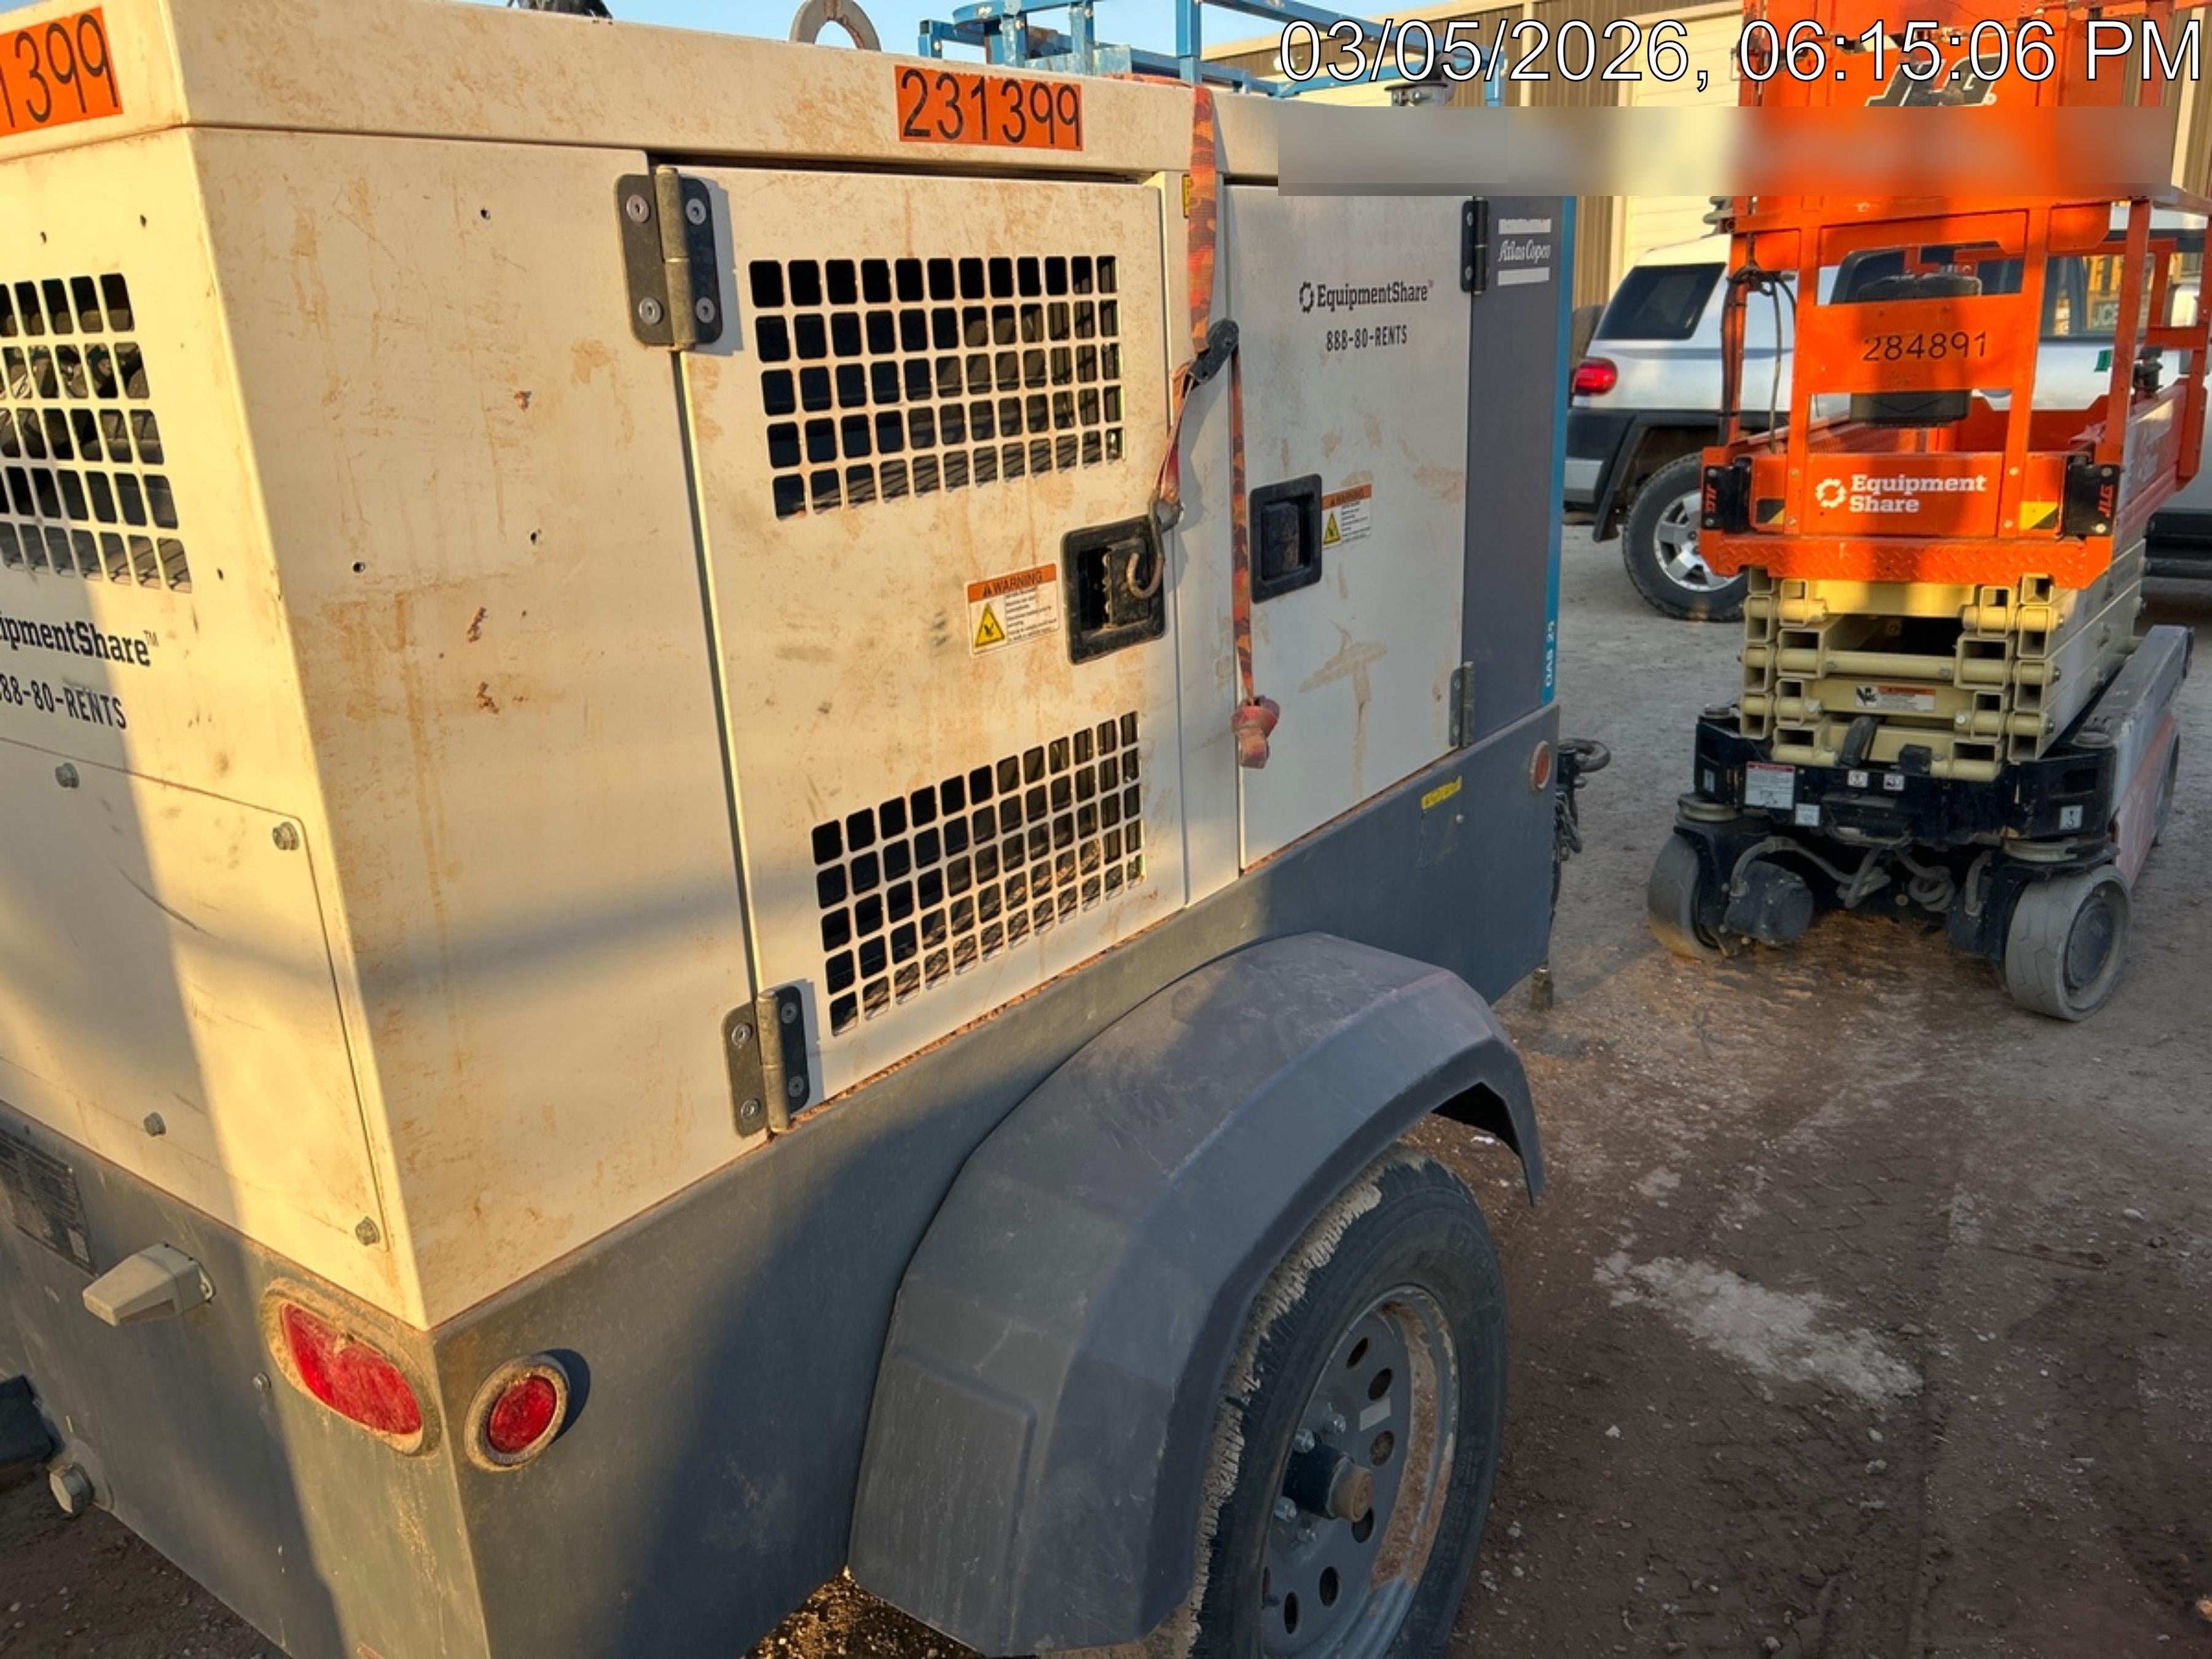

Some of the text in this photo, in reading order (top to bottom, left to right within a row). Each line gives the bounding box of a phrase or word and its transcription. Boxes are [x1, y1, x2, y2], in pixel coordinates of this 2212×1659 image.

[901, 68, 1081, 146] 231399
[1497, 239, 1525, 262] Atlas
[1326, 324, 1408, 352] 888-80-RENTS
[1862, 331, 1987, 362] 284891
[1850, 474, 1987, 495] Equipment
[1849, 495, 1920, 514] Share
[993, 570, 1043, 595] WARNING
[0, 673, 127, 729] 88-80-RENTS
